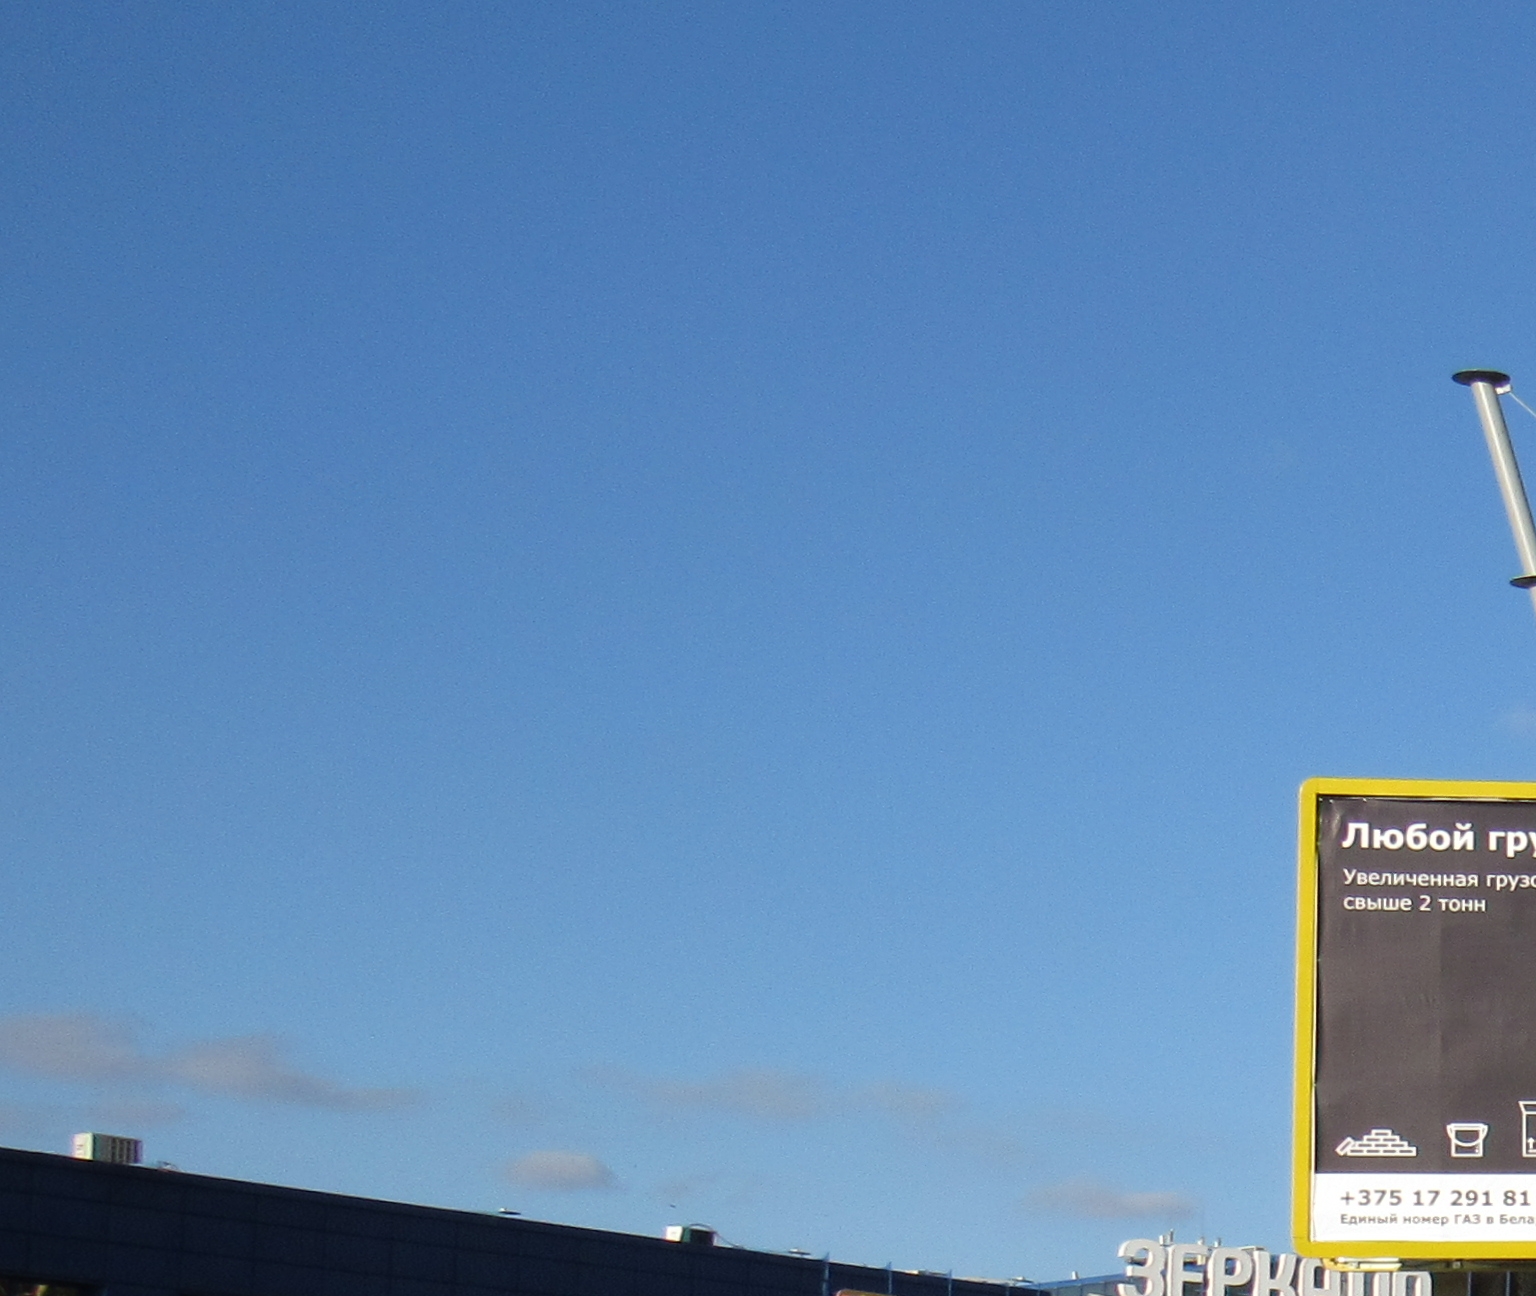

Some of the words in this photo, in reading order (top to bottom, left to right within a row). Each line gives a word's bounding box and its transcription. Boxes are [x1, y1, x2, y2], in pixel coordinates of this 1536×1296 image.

[1342, 822, 1475, 850] Любой
[1342, 869, 1479, 888] Увеличенная
[1343, 896, 1412, 911] свыше
[1419, 895, 1431, 912] 2
[1438, 898, 1486, 912] тонн
[1340, 1190, 1402, 1206] +375
[1413, 1190, 1440, 1206] 17
[1450, 1190, 1493, 1206] 291
[1503, 1190, 1531, 1206] 81
[1340, 1213, 1398, 1225] Единый
[1403, 1215, 1449, 1226] номер
[1454, 1214, 1481, 1225] ГАЗ
[1486, 1216, 1494, 1225] в
